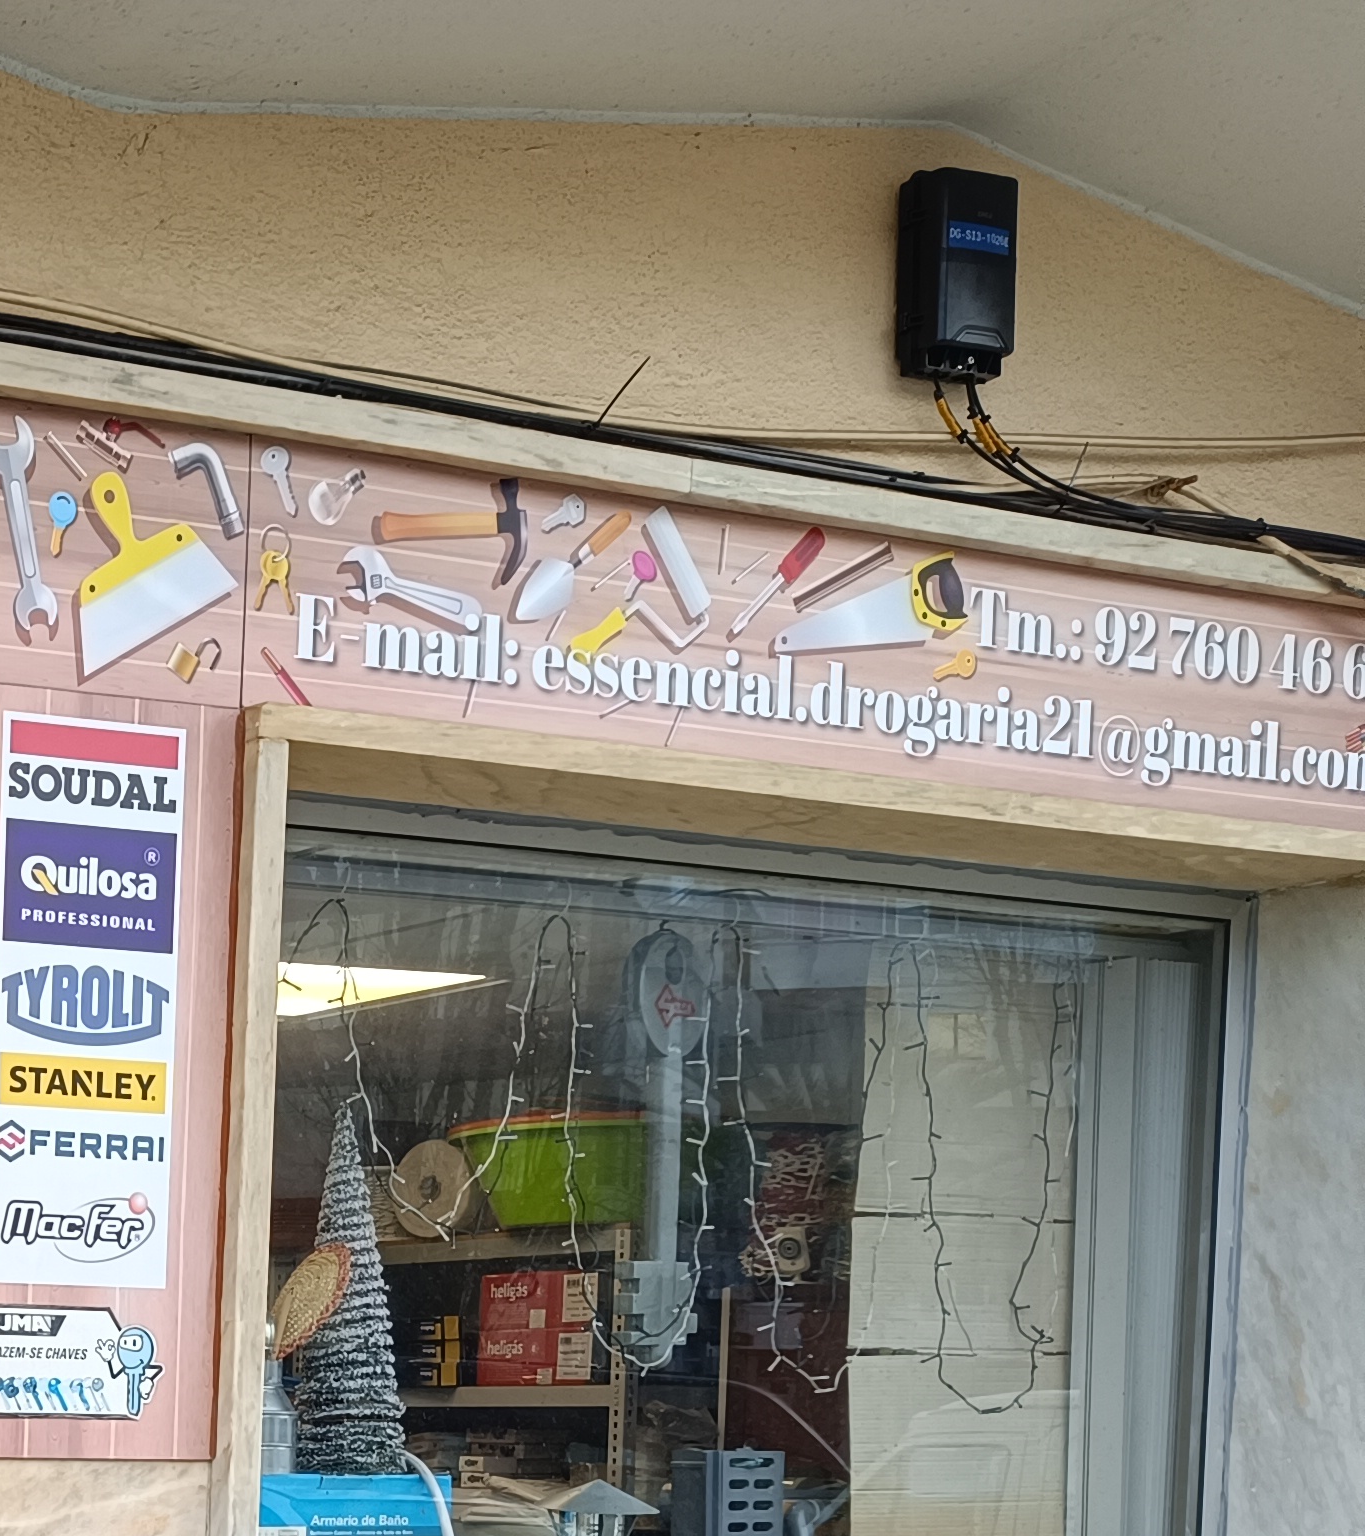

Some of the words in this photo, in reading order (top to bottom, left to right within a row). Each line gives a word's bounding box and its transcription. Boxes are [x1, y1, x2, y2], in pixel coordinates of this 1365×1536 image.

[294, 592, 519, 686] E-mail:
[1094, 606, 1158, 671] 92
[1170, 617, 1261, 685] 760
[1269, 633, 1333, 695] 46
[8, 761, 177, 813] SOUDAL
[20, 855, 157, 900] Quilosa
[20, 908, 156, 932] PROFESSIONAL
[1, 964, 170, 1044] TYROLIT
[29, 1129, 164, 1162] FERRAI
[490, 1282, 528, 1301] heligás
[44, 1347, 88, 1360] CHAVES
[487, 1340, 523, 1358] heligás
[310, 1514, 359, 1526] Armario
[361, 1514, 376, 1526] de
[379, 1514, 409, 1526] Baño
